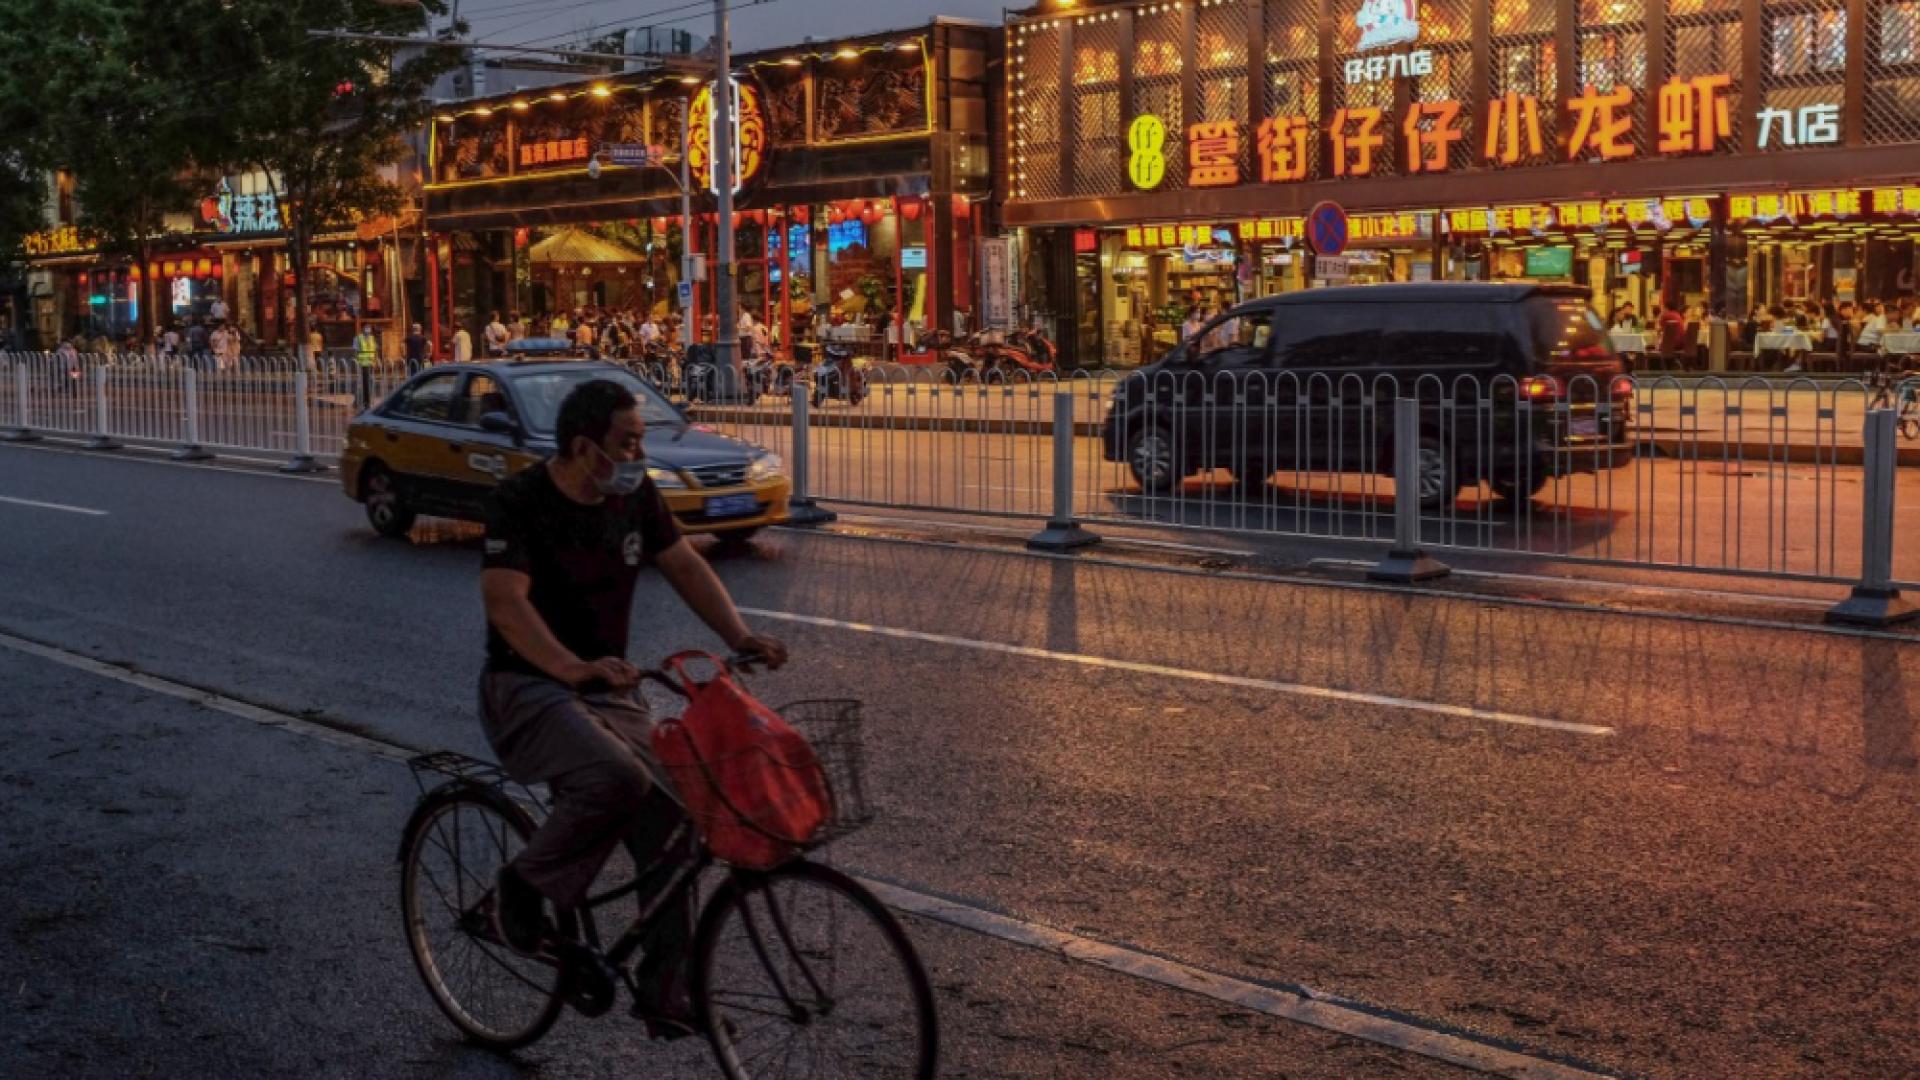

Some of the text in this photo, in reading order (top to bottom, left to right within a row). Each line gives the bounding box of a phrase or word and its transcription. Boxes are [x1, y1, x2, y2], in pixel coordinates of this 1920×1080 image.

[1344, 50, 1433, 85] 仔仔九店
[1188, 73, 1840, 188] 簋街仔仔小龙虾 九店
